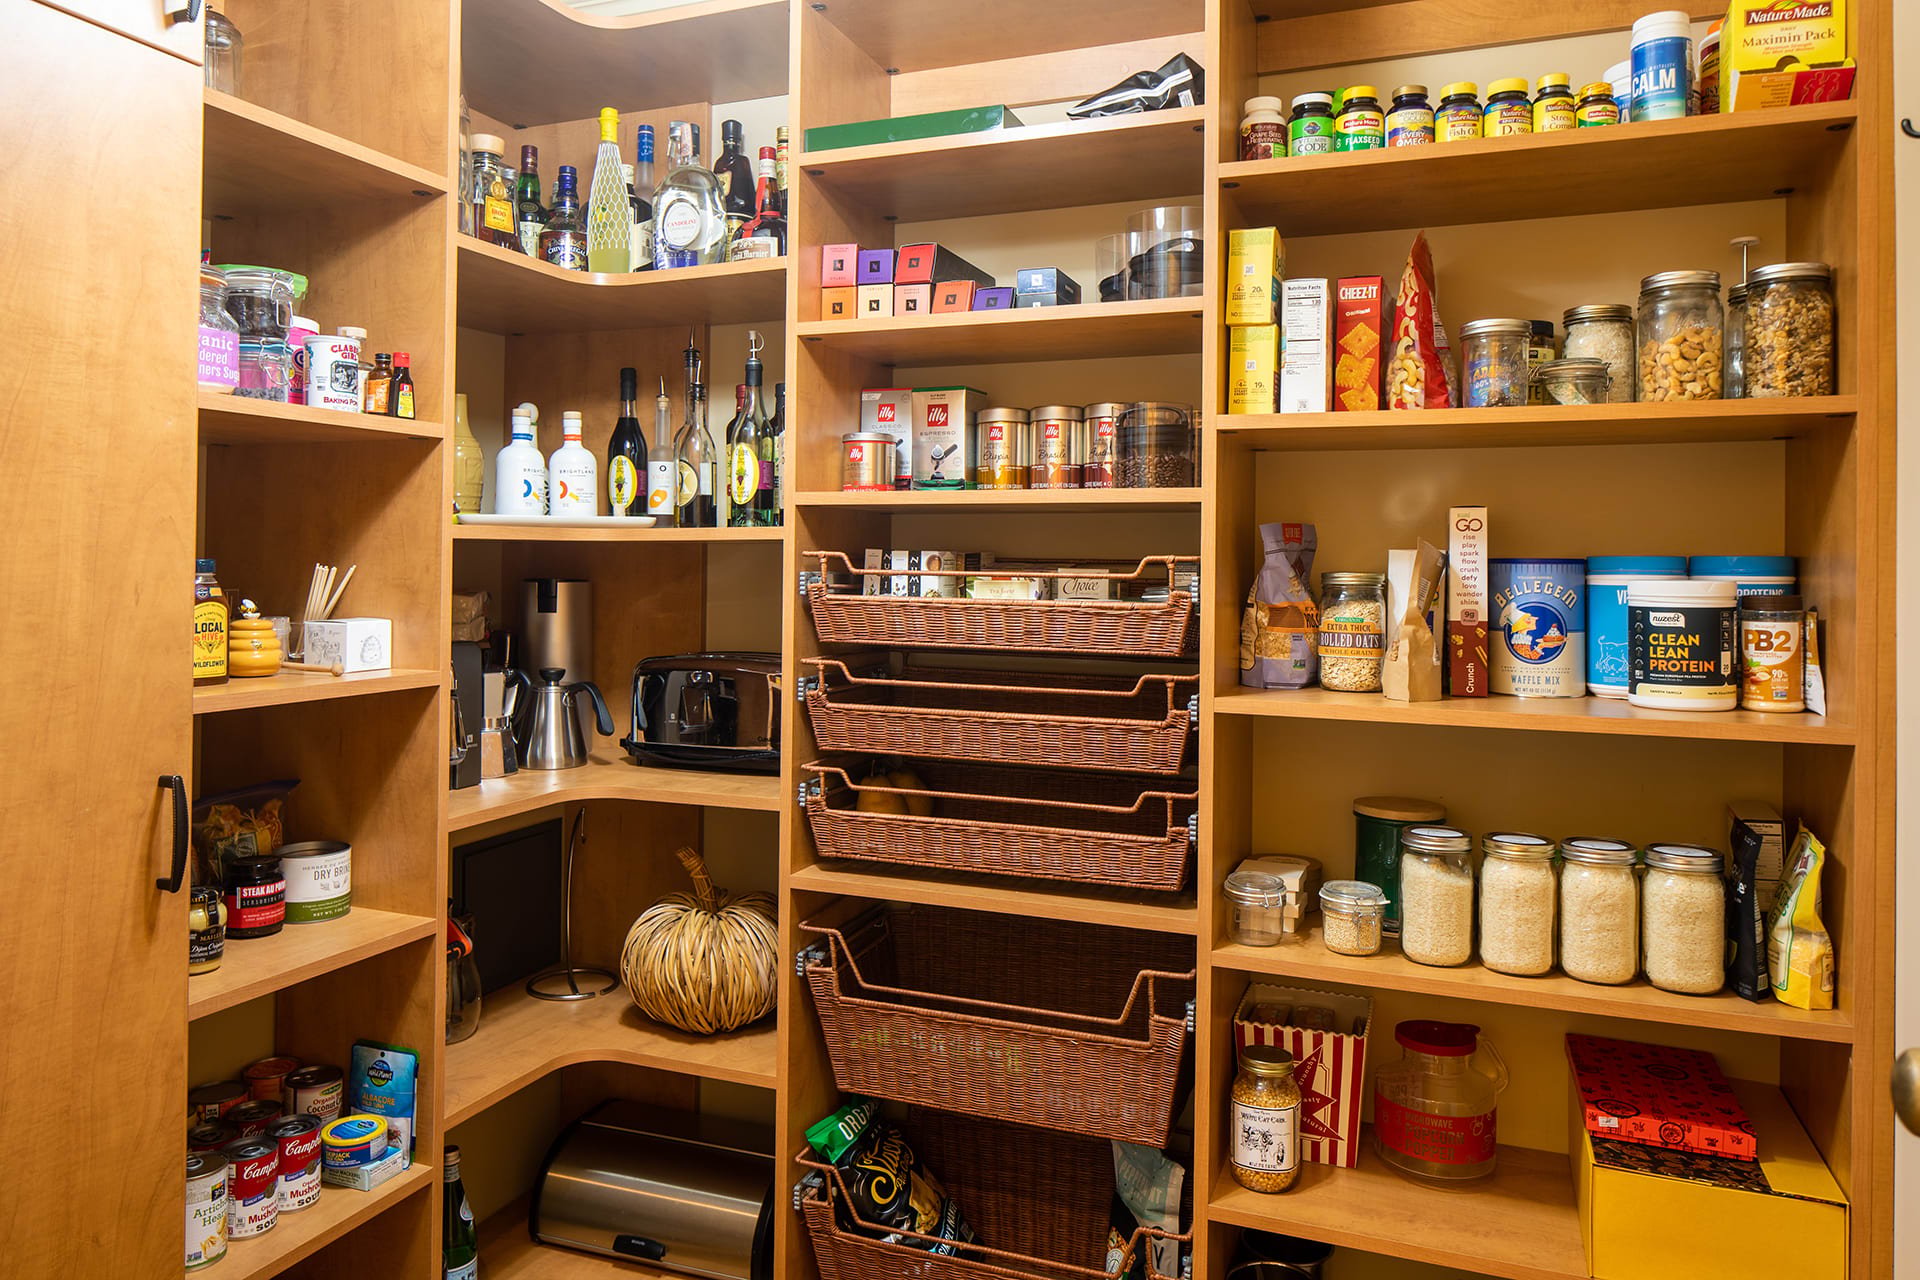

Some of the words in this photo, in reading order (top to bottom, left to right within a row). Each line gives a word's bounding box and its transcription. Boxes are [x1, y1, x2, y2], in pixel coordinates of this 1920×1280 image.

[1749, 11, 1792, 24] Nature
[1743, 33, 1800, 48] Maximin
[1806, 28, 1836, 41] Pack
[1632, 67, 1676, 98] CALM
[1448, 128, 1466, 136] Fish
[1346, 136, 1380, 146] FLAXSEED
[1298, 143, 1327, 153] CODE
[878, 406, 894, 422] illy
[928, 407, 948, 426] illy
[990, 427, 1003, 439] illy
[1046, 424, 1059, 438] illy
[850, 448, 863, 461] illy
[1456, 518, 1483, 532] GO
[1062, 578, 1099, 595] Choice
[1494, 580, 1577, 609] BELLEGEM
[1464, 611, 1474, 619] 9g
[1652, 614, 1680, 622] nuzest
[195, 622, 224, 634] LOCAL
[1327, 623, 1348, 632] EXTRA
[1350, 622, 1371, 632] THICK
[202, 632, 219, 641] HIVE
[1320, 634, 1353, 648] ROLLED
[1356, 634, 1379, 648] OATS
[1649, 633, 1700, 646] CLEAN
[1744, 630, 1792, 652] PB2
[1649, 646, 1689, 659] LEAN
[1649, 659, 1715, 672] PROTEIN
[1466, 662, 1475, 694] Crunch
[1512, 674, 1541, 684] WAFFLE
[1545, 676, 1560, 685] MIX
[1772, 669, 1788, 678] 90%
[314, 869, 332, 880] DRY
[242, 885, 266, 897] STEAK
[266, 882, 274, 894] AU
[313, 1096, 336, 1106] Organic
[362, 1092, 395, 1106] ALBACORE
[306, 1101, 336, 1114] Coconut
[1258, 1114, 1270, 1124] CAT
[1405, 1112, 1454, 1129] MICROWAVE
[1405, 1124, 1464, 1144] POPCORN
[1405, 1139, 1454, 1161] POPPER
[302, 1178, 314, 1188] Cream
